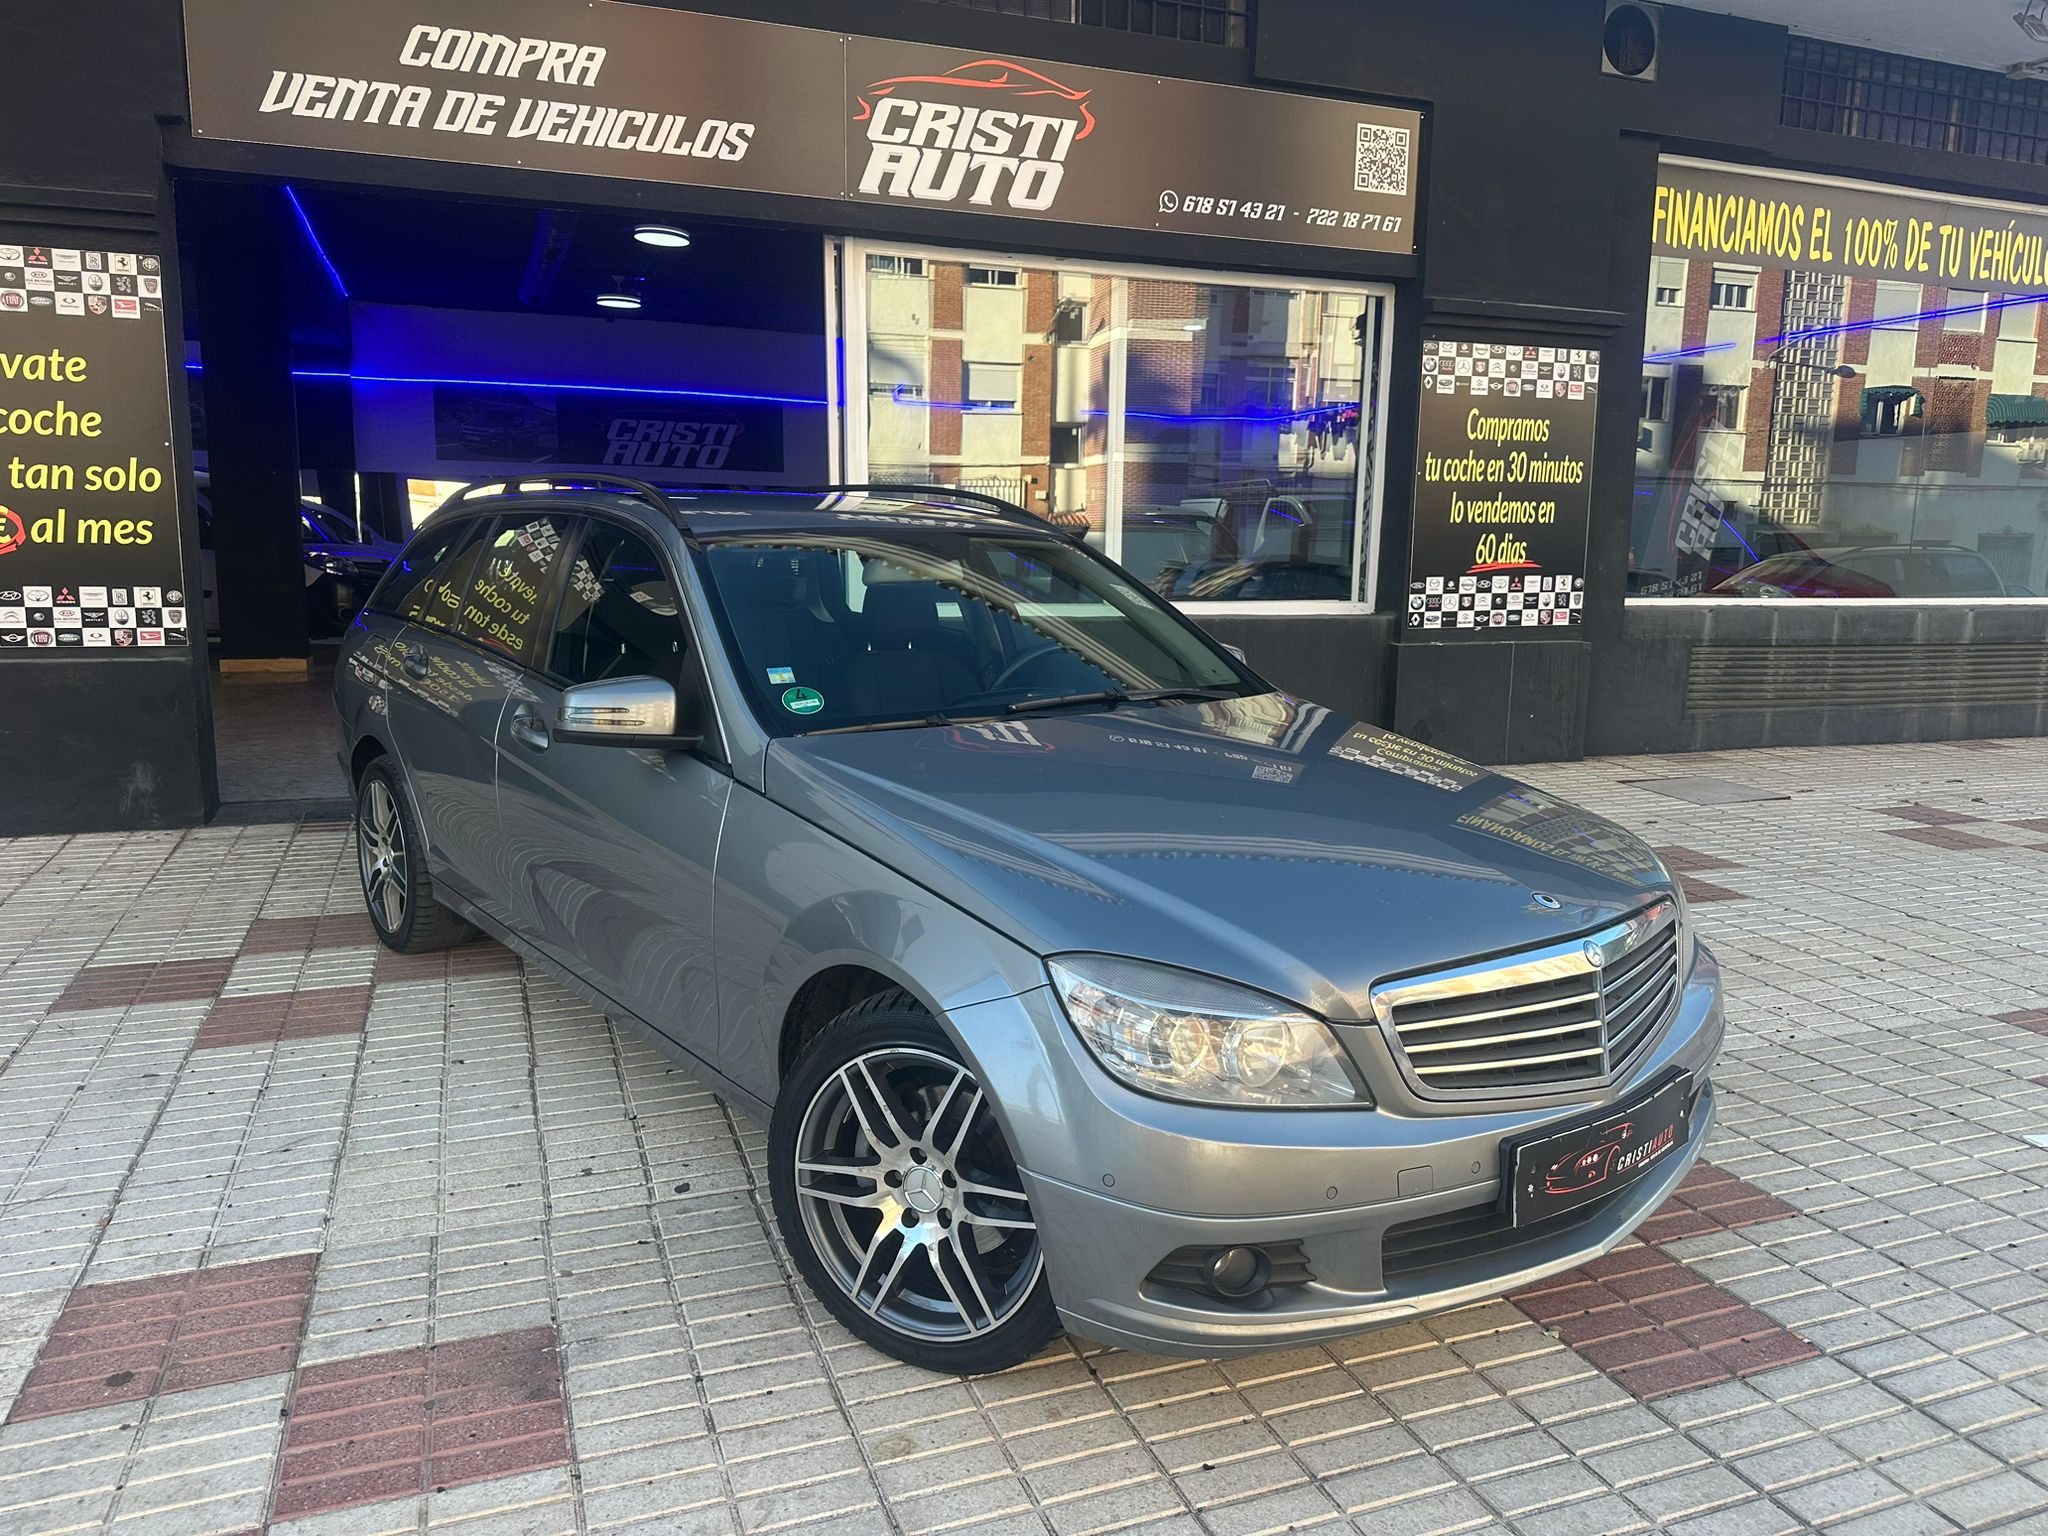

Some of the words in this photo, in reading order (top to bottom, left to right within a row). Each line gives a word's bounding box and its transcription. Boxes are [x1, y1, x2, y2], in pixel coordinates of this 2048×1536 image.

[399, 24, 607, 87] COMPRA
[258, 70, 433, 128] VENTA
[432, 89, 506, 136] DE
[506, 97, 756, 162] VEHICULOS
[866, 97, 1079, 162] CRISTI
[857, 142, 1065, 211] AUTO
[1183, 195, 1215, 214] 618
[1215, 198, 1238, 217] 51
[1239, 201, 1264, 219] 43
[1264, 204, 1286, 221] 21
[1306, 207, 1339, 227] 722
[1342, 211, 1361, 229] 18
[1360, 213, 1382, 231] 71
[1381, 215, 1403, 233] 61
[1651, 186, 1805, 262] FINANCIAMOS
[1809, 207, 1833, 263] EL
[1844, 218, 1898, 270] 100%
[1904, 218, 1934, 273] DE
[1938, 224, 1965, 278] TU
[5, 295, 19, 305] FIAT
[606, 418, 738, 446] CRISTI
[1467, 408, 1550, 447] Compramos
[602, 440, 730, 468] AUTO
[1425, 452, 1442, 482] tu
[1443, 450, 1484, 482] coche
[1487, 459, 1505, 482] en
[1507, 451, 1528, 483] 30
[1528, 452, 1583, 484] minutos
[8, 456, 75, 490] tan
[84, 456, 162, 494] solo
[1450, 491, 1463, 523] lo
[1467, 492, 1536, 524] vendemos
[1538, 501, 1555, 524] en
[30, 508, 66, 544] al
[77, 518, 154, 545] mes
[1475, 534, 1496, 564] 60
[1498, 534, 1527, 564] dias
[34, 634, 49, 643] FIAT
